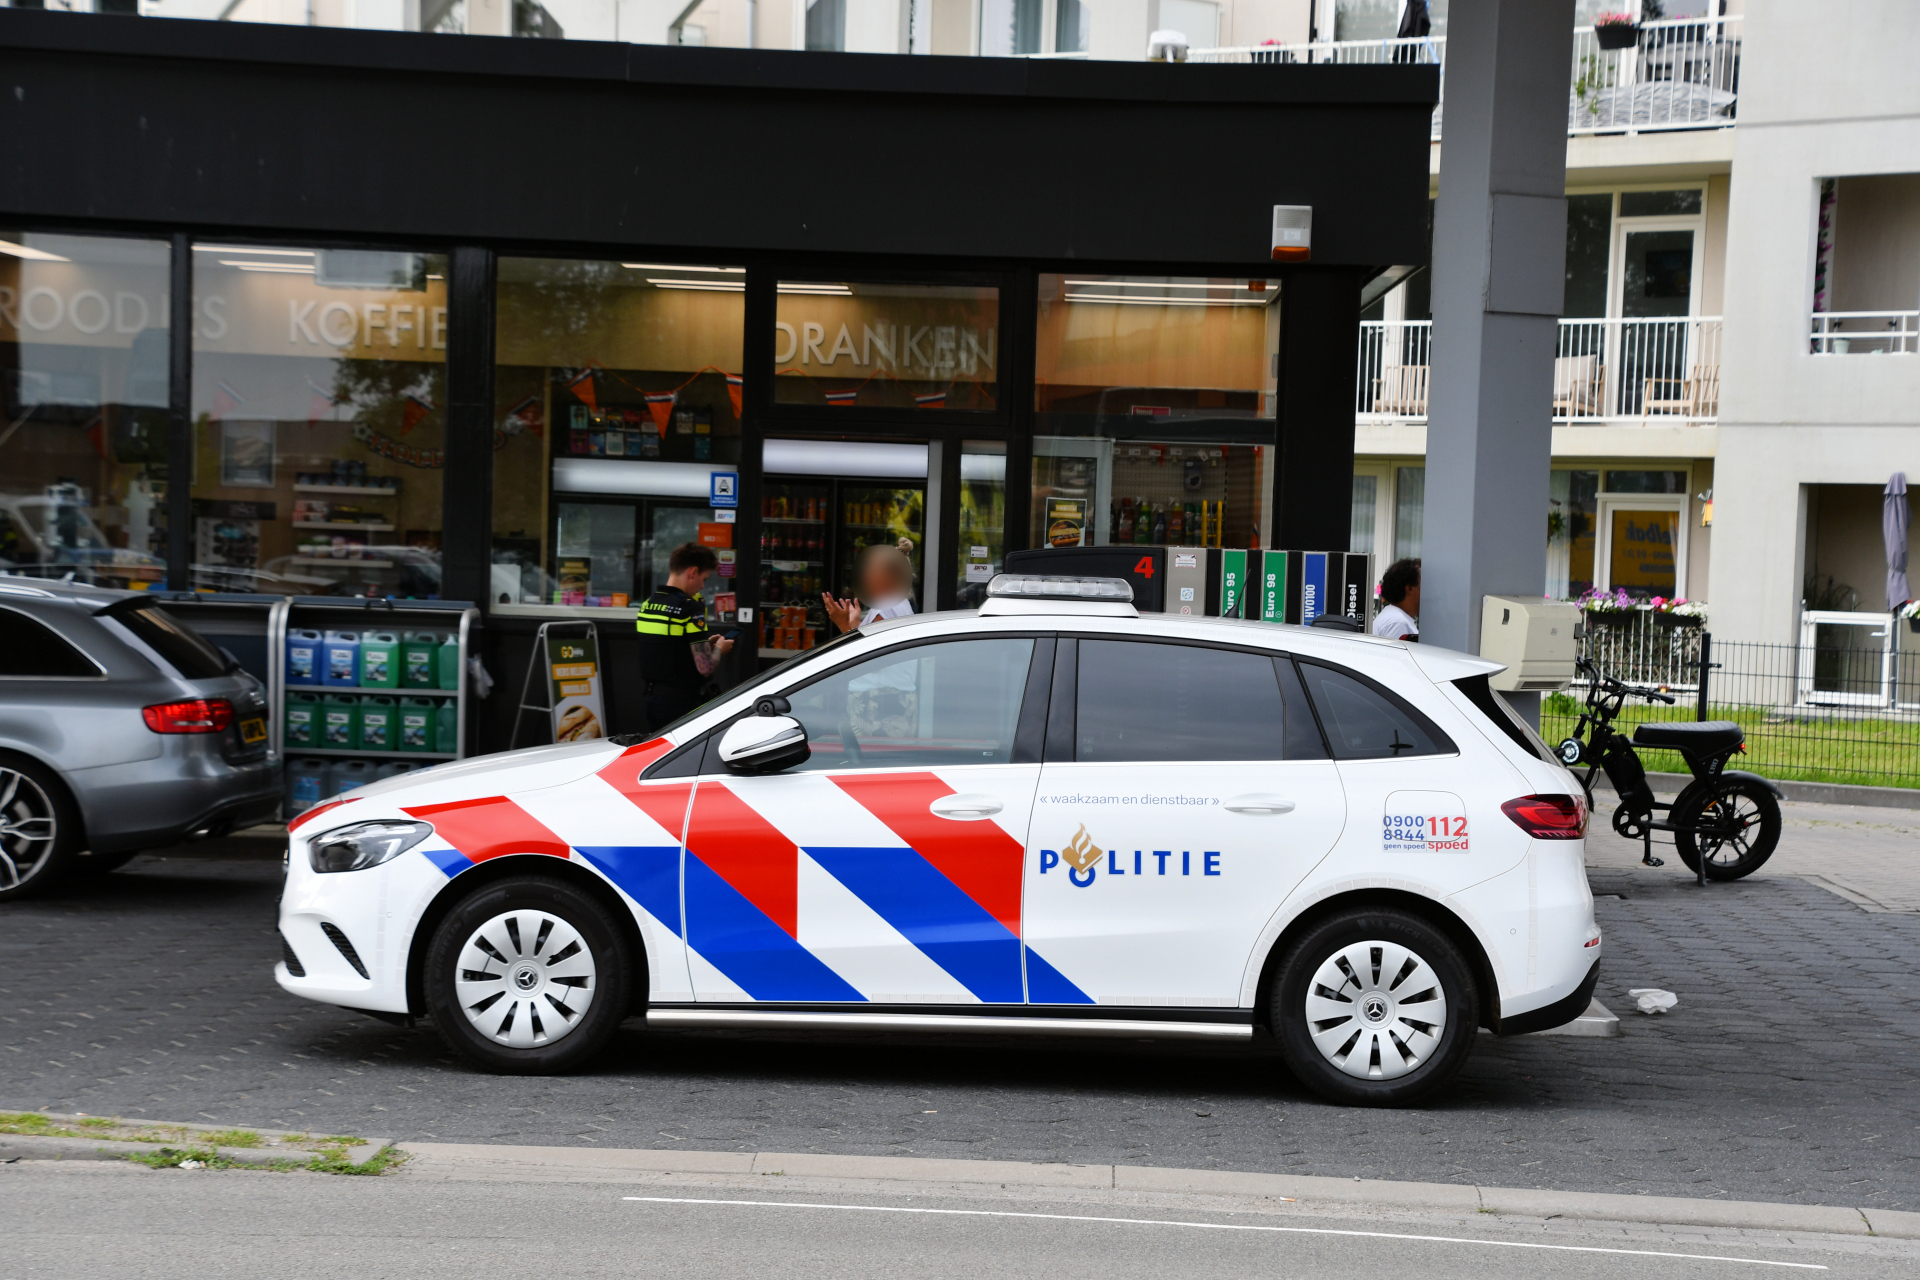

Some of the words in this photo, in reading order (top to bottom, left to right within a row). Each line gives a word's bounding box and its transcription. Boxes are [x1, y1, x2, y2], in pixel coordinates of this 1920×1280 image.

[289, 299, 447, 350] KOFFIE
[775, 321, 994, 370] DRANKEN
[1134, 556, 1154, 578] 4
[1226, 572, 1236, 587] 95
[1267, 573, 1276, 588] 98
[1225, 590, 1235, 614] uro
[1265, 591, 1275, 618] Euro
[1304, 584, 1316, 618] HVO100
[1050, 793, 1119, 804] waakzaam
[1122, 796, 1138, 804] en
[1140, 794, 1209, 805] dienstbaar
[1383, 815, 1424, 827] 0900
[1427, 816, 1468, 836] 112
[1383, 829, 1425, 841] 8844
[1403, 843, 1425, 851] spoed
[1428, 839, 1468, 852] spoed
[1040, 849, 1221, 888] POLITIE
